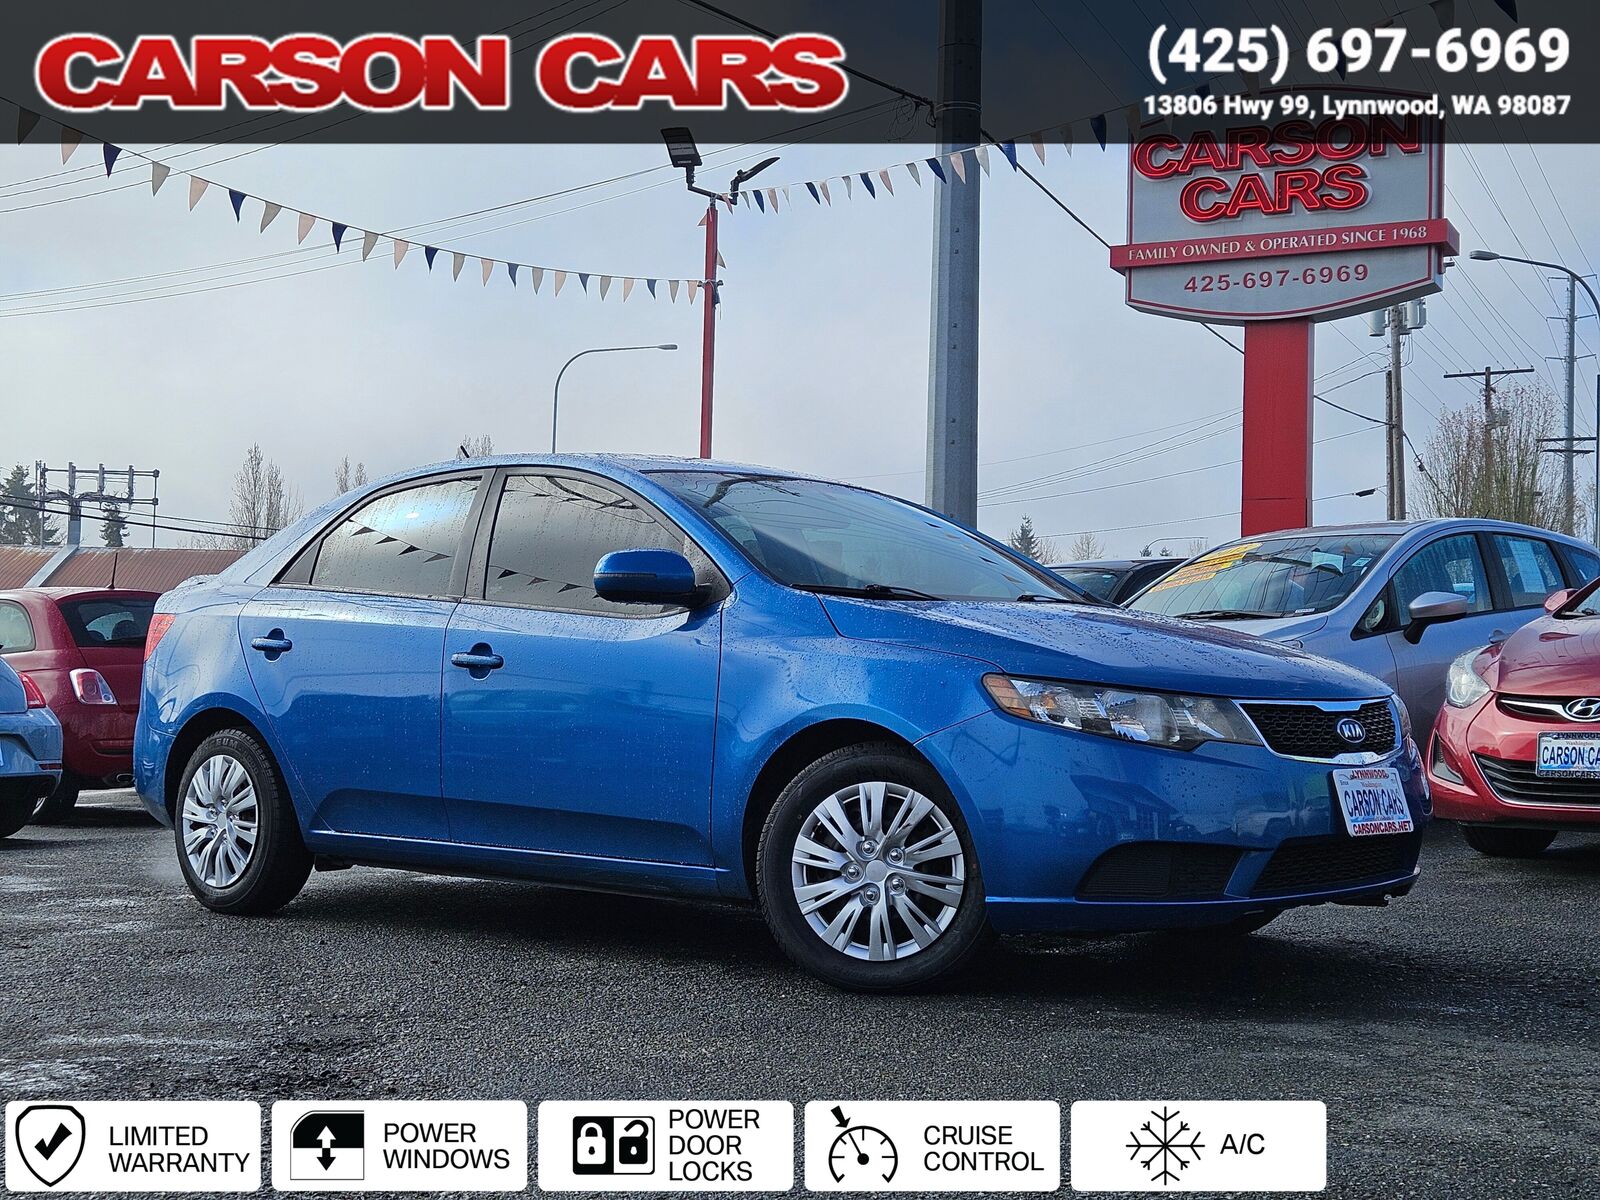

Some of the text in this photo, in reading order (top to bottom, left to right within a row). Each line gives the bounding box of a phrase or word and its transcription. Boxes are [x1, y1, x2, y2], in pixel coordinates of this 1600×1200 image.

[1134, 114, 1423, 179] CARSON
[1180, 163, 1370, 222] CARS
[1129, 226, 1427, 260] FAMILY OWNED & OPERATED SINCE 1968
[1183, 264, 1369, 293] 425-697-6969
[1341, 723, 1363, 738] KIA
[1542, 746, 1585, 765] CARSON
[1344, 789, 1381, 817] CARSON
[1353, 820, 1411, 835] CARSONCARS.NET
